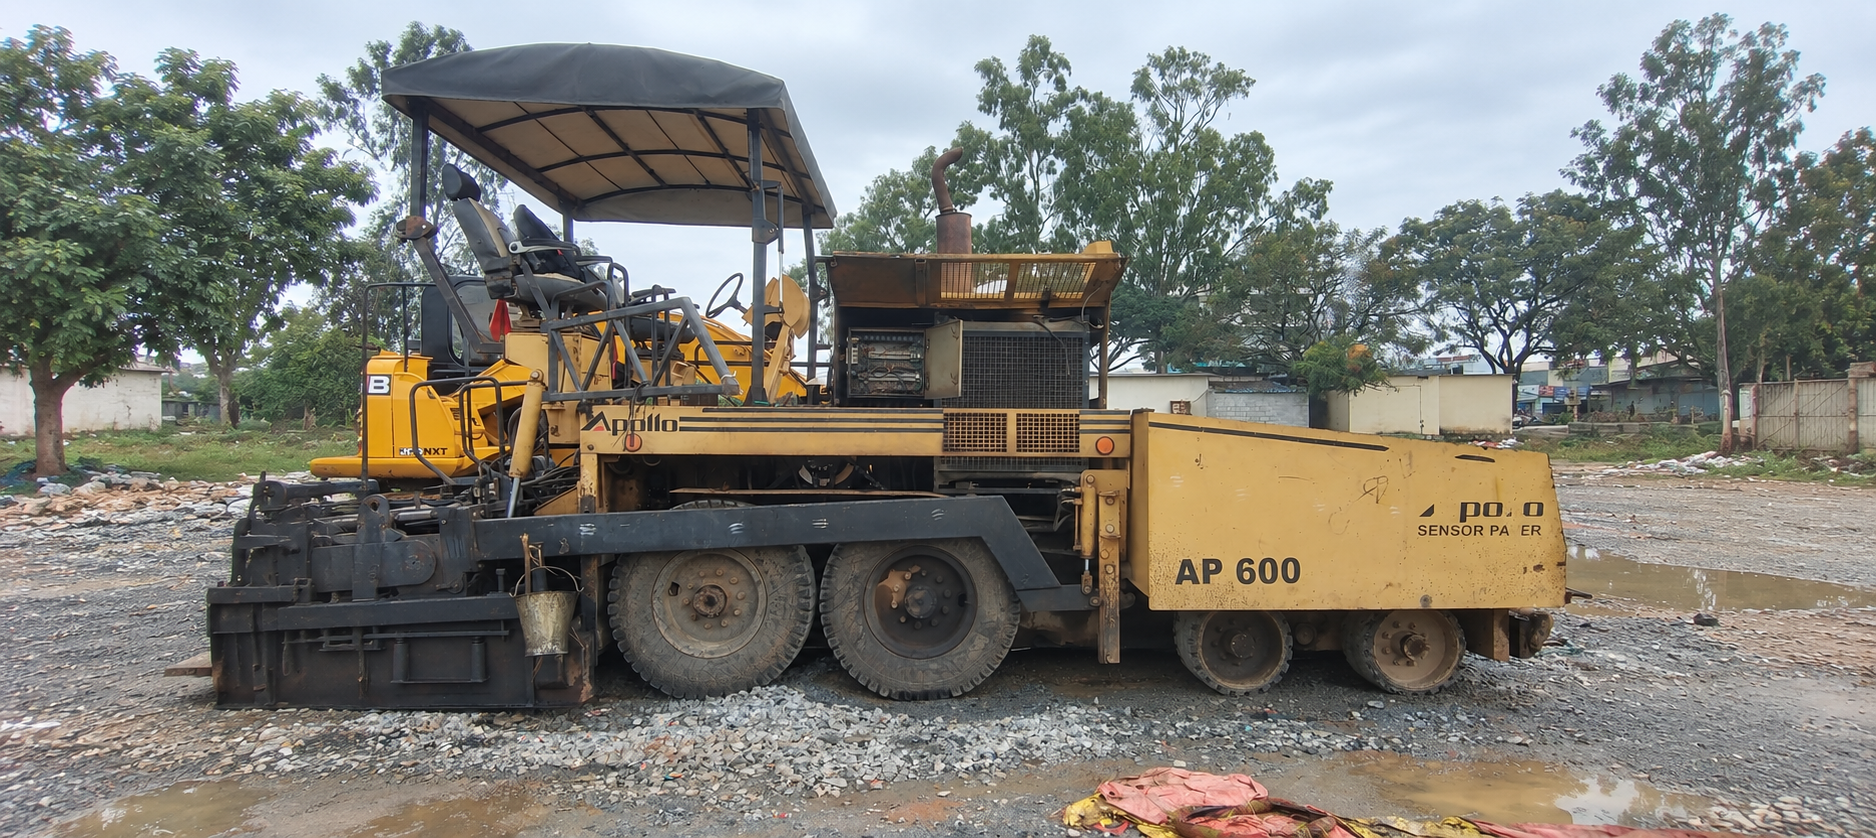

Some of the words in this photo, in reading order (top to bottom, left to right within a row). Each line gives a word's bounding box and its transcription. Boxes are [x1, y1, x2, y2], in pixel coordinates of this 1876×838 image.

[581, 411, 678, 436] Apollo
[1417, 524, 1484, 536] SENSOR
[1490, 524, 1542, 536] PAER
[1175, 558, 1223, 585] AP
[1236, 557, 1301, 585] 600
